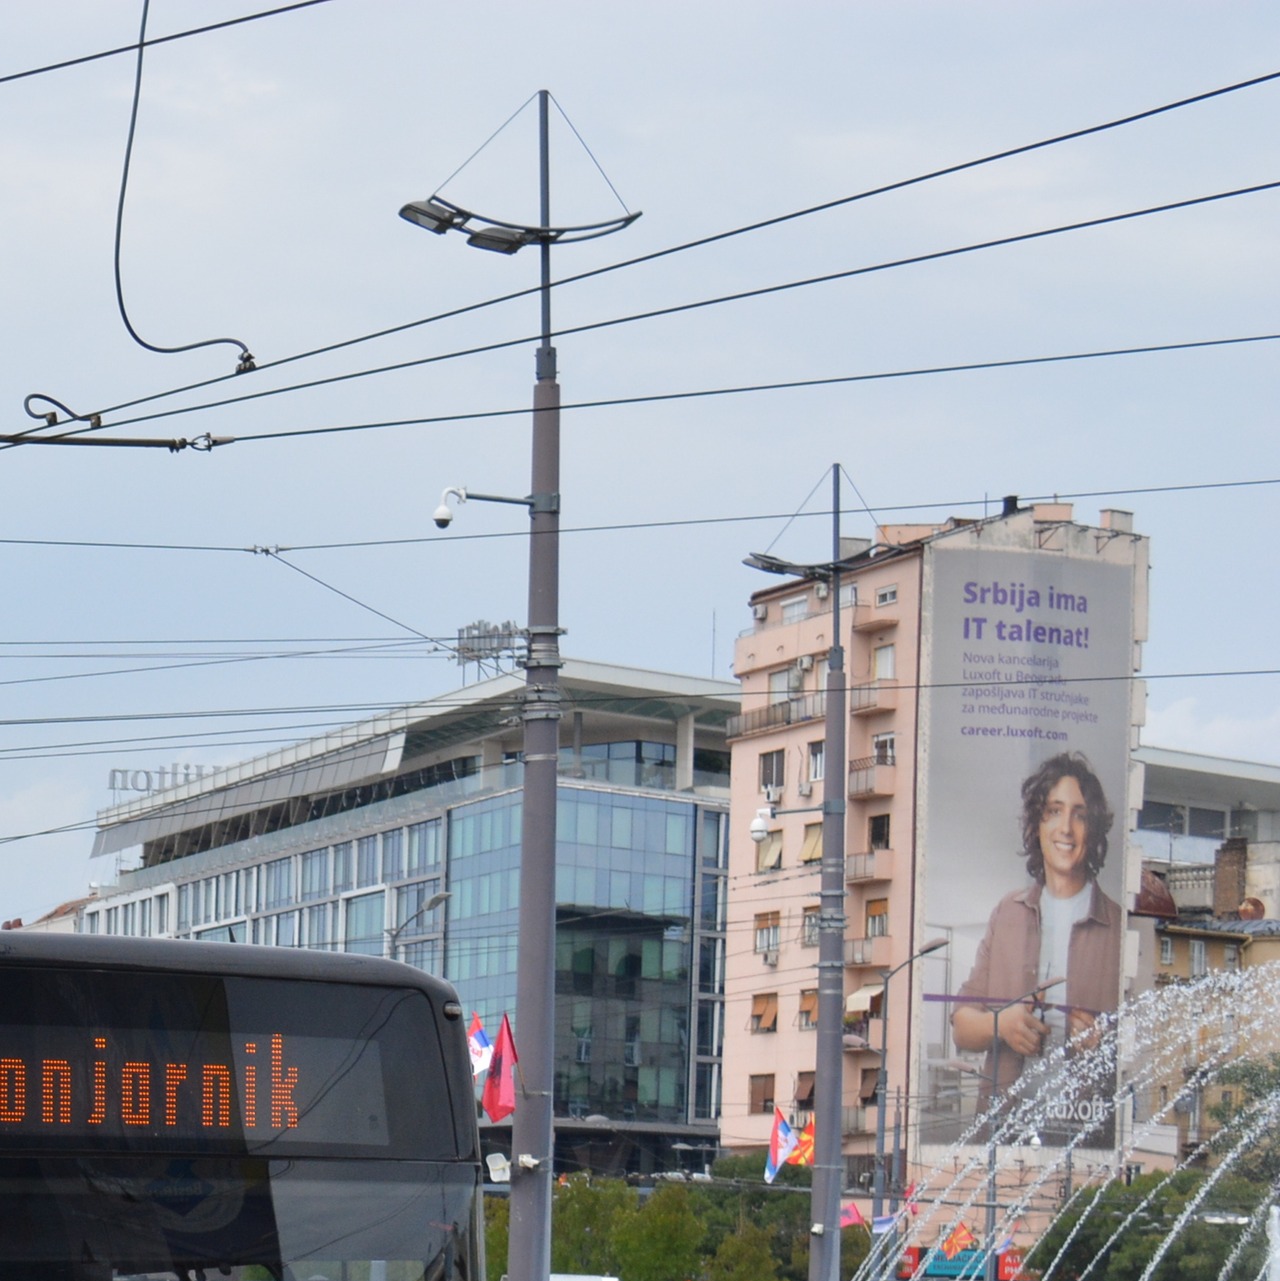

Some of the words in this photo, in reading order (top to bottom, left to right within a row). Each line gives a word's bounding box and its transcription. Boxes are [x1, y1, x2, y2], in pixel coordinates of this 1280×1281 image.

[963, 581, 1041, 613] Srbija
[1048, 585, 1088, 613] ima
[963, 617, 987, 640] IT
[996, 619, 1089, 649] talenat!
[962, 652, 995, 664] Nova
[998, 652, 1059, 671] kancelarija
[962, 668, 1001, 682] Luxoft
[961, 685, 1025, 701] zapošljava
[961, 704, 975, 714] za
[960, 724, 1069, 742] career.luxoft.com
